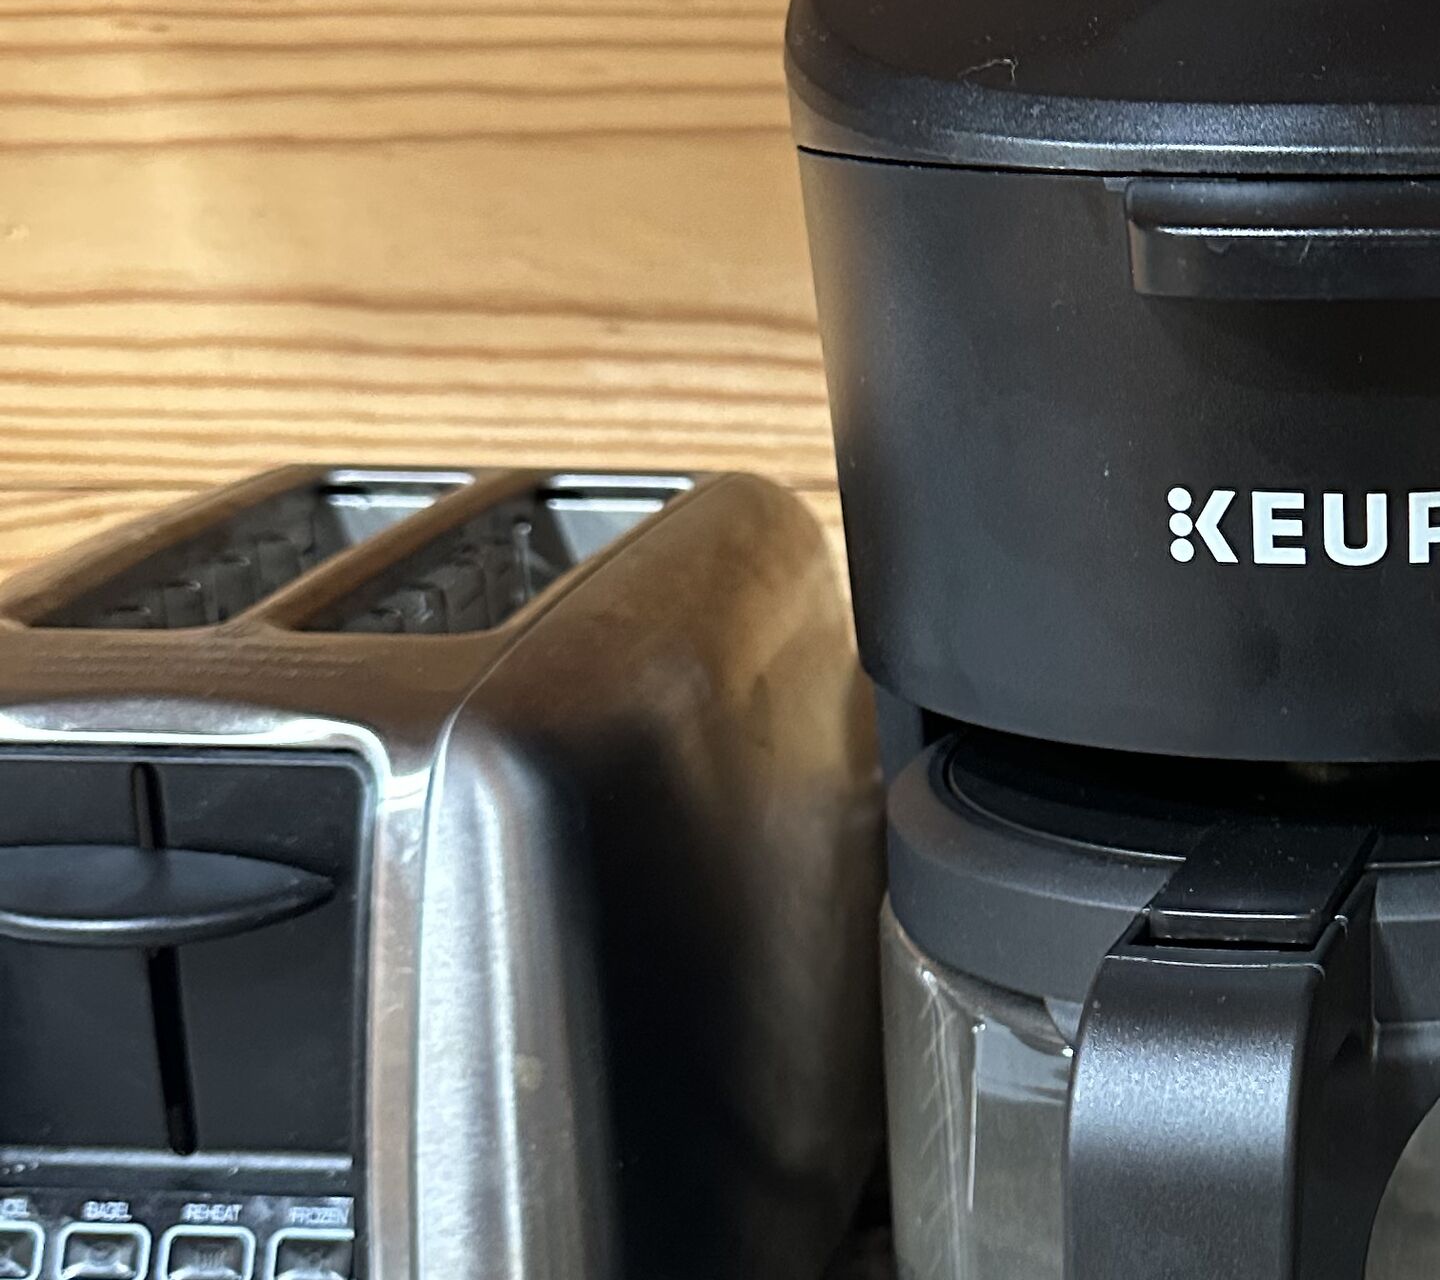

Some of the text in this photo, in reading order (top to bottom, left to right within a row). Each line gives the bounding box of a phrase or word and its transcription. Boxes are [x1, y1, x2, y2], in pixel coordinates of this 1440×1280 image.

[83, 1201, 132, 1221] BAGEL
[181, 1203, 243, 1222] REHEAT
[289, 1206, 350, 1224] FROZEN
